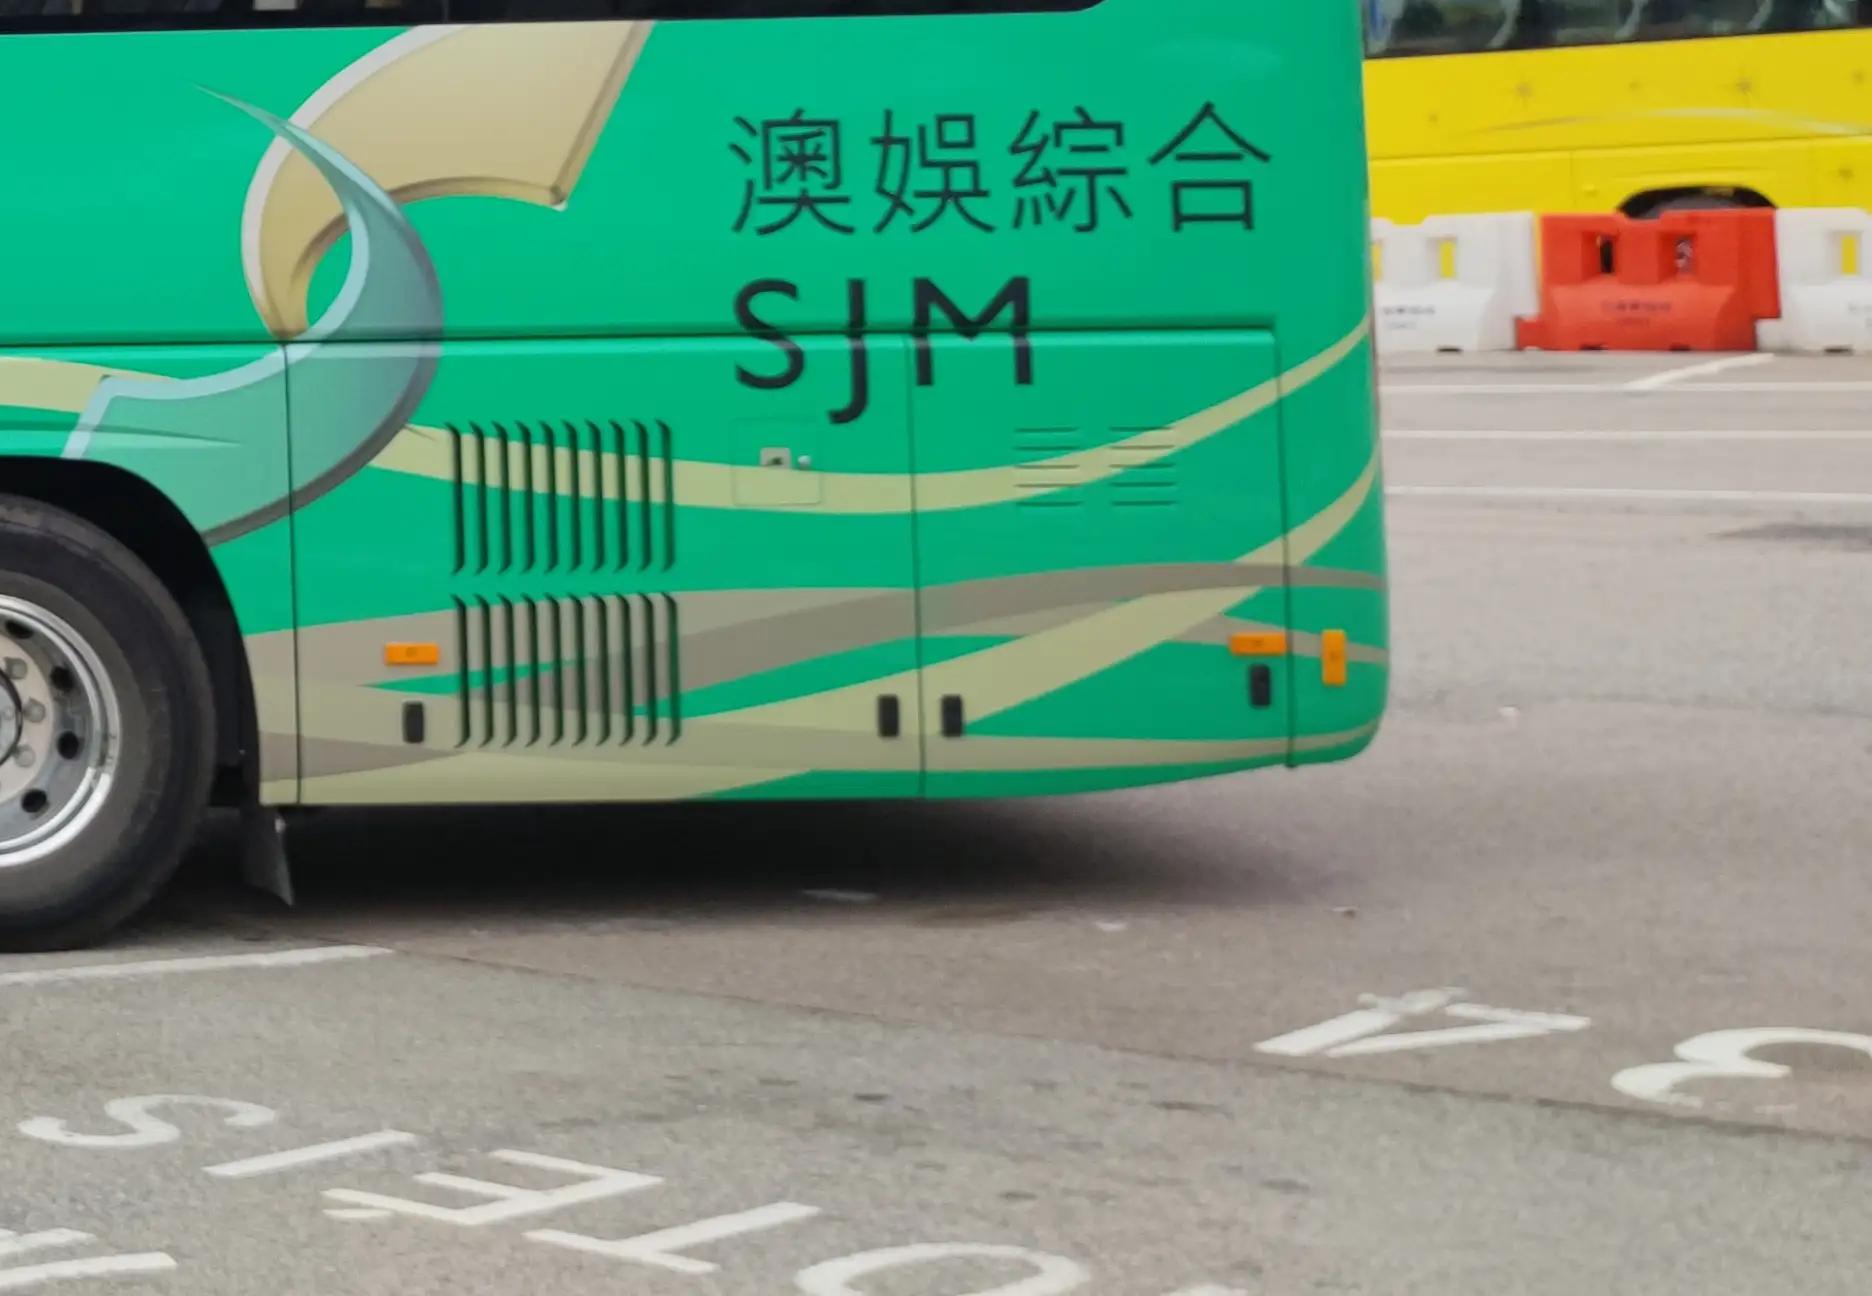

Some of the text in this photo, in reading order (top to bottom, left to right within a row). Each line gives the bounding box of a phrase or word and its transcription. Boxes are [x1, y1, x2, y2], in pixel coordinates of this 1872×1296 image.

[728, 100, 1272, 236] 澳娛綜合
[732, 274, 1034, 426] SJM
[17, 1094, 1250, 1296] OTÉIS
